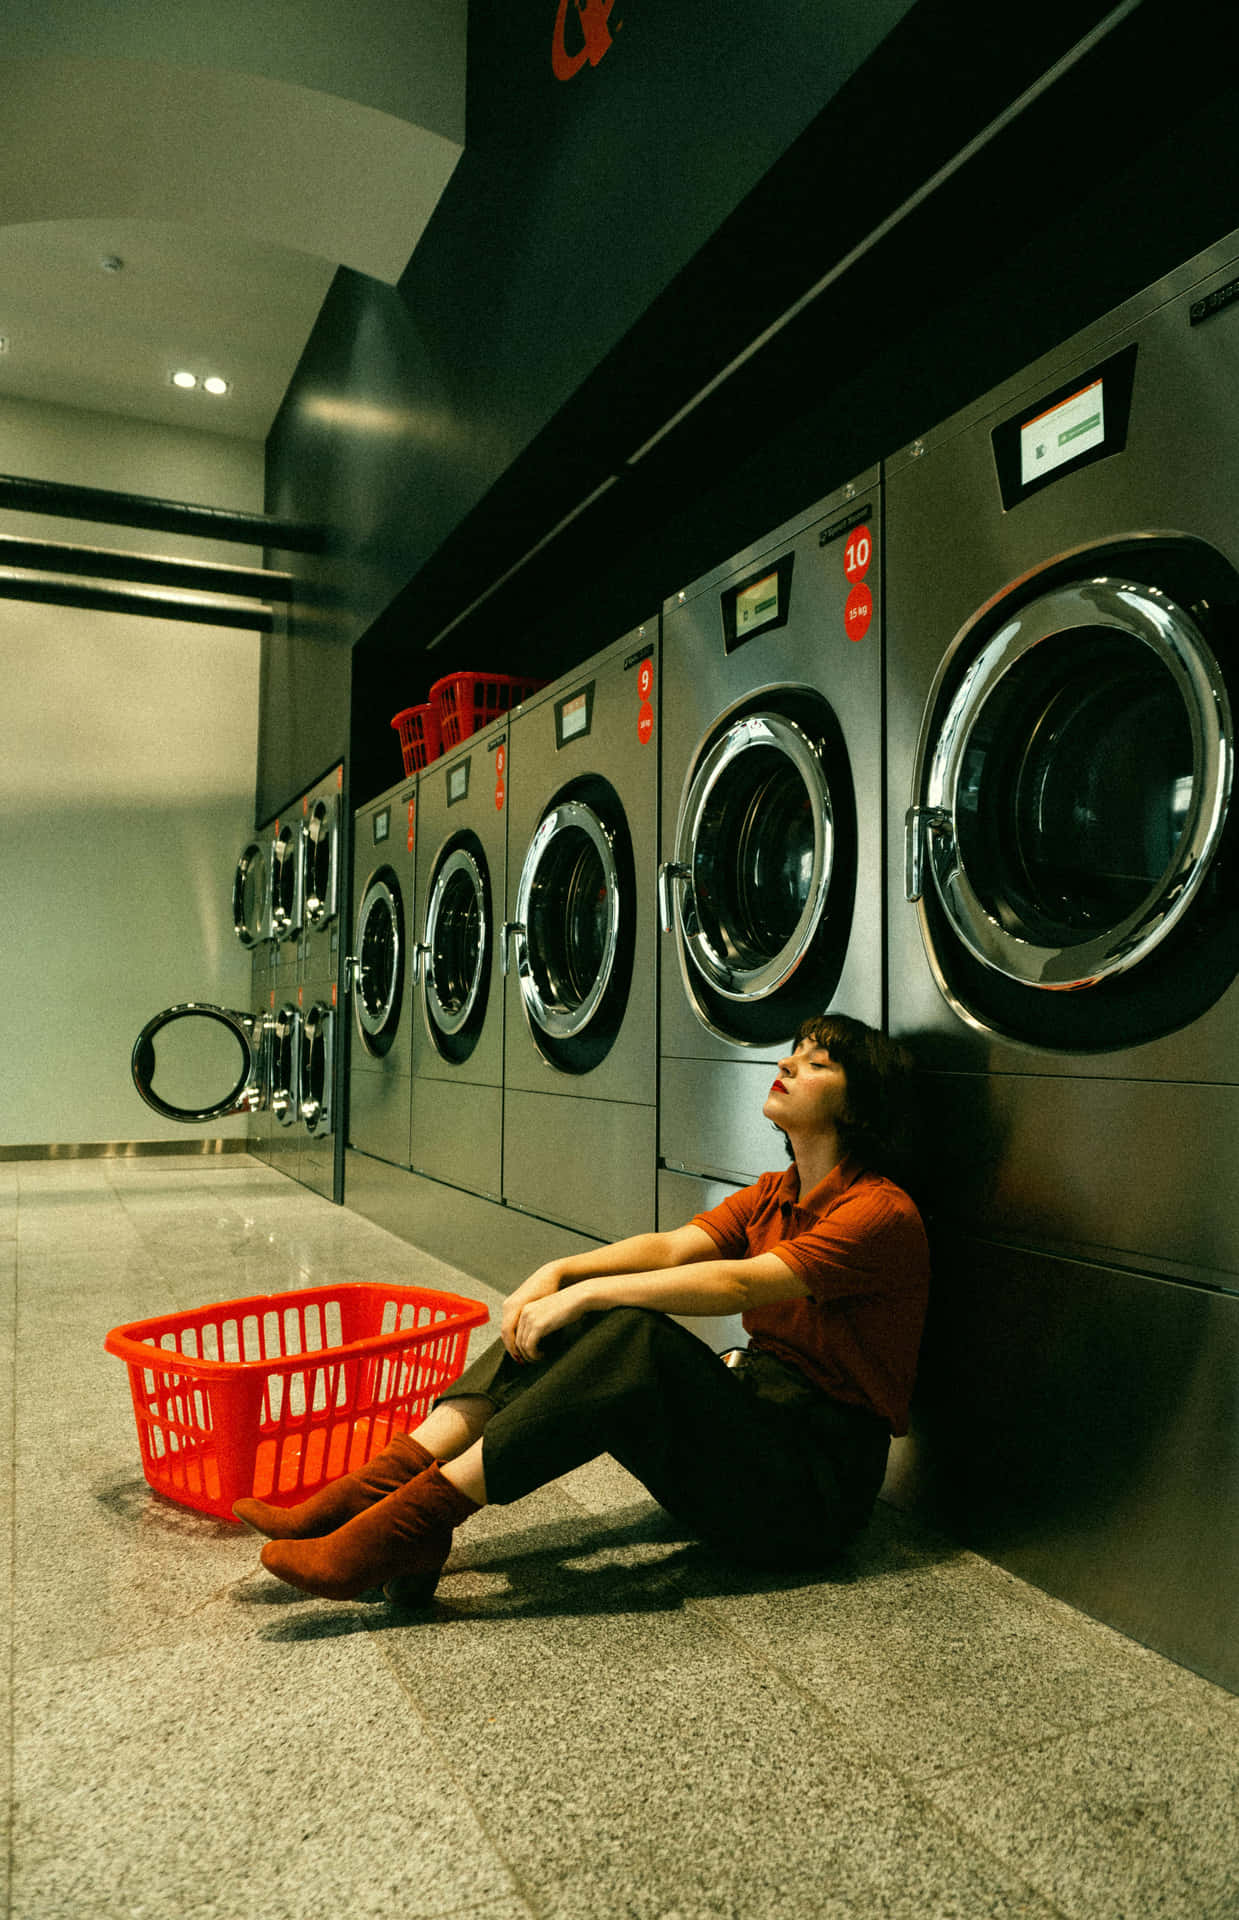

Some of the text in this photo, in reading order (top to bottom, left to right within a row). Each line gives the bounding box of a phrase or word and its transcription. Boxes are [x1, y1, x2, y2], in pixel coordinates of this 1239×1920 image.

[846, 538, 869, 572] 10
[849, 604, 868, 619] 15 kg
[642, 670, 649, 691] 9
